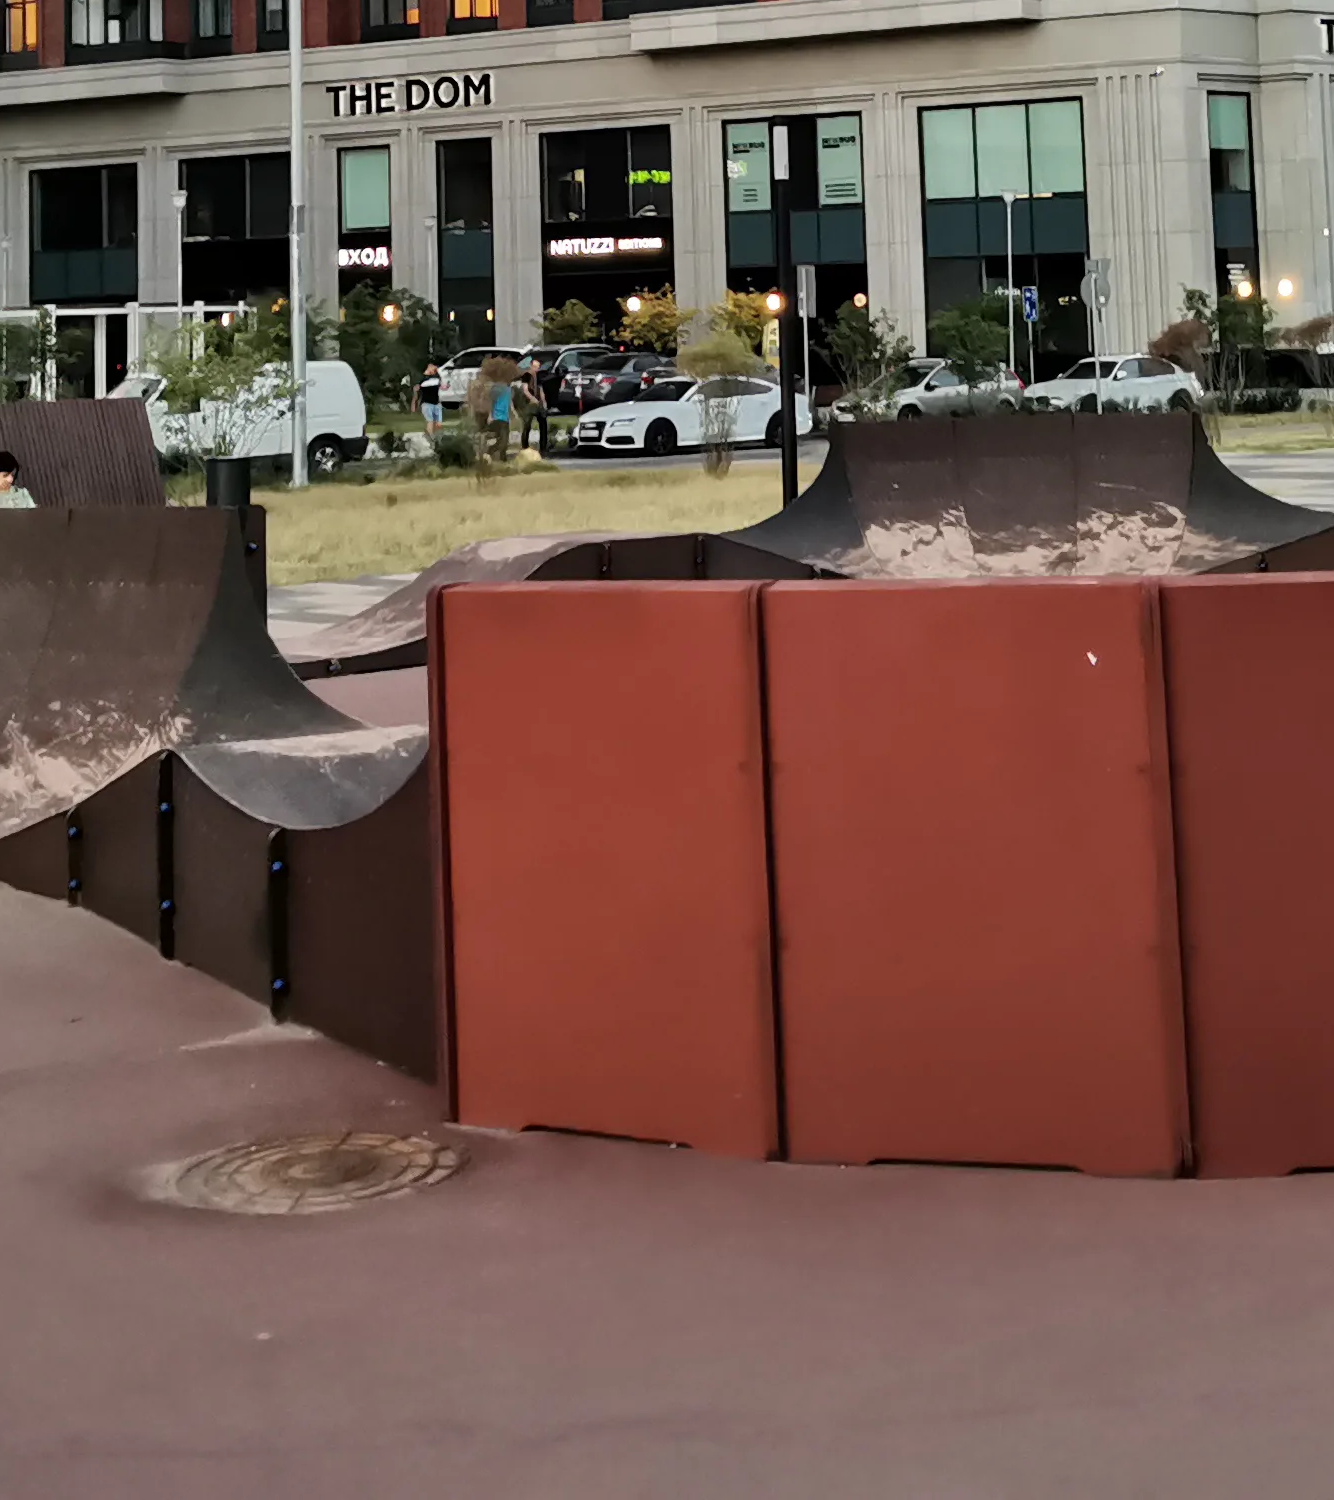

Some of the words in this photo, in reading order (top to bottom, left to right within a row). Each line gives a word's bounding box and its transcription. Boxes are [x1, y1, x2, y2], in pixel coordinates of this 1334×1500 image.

[325, 81, 396, 117] THE
[405, 73, 491, 111] DOM
[338, 246, 389, 268] ВХОД
[550, 237, 614, 256] NATUZZI
